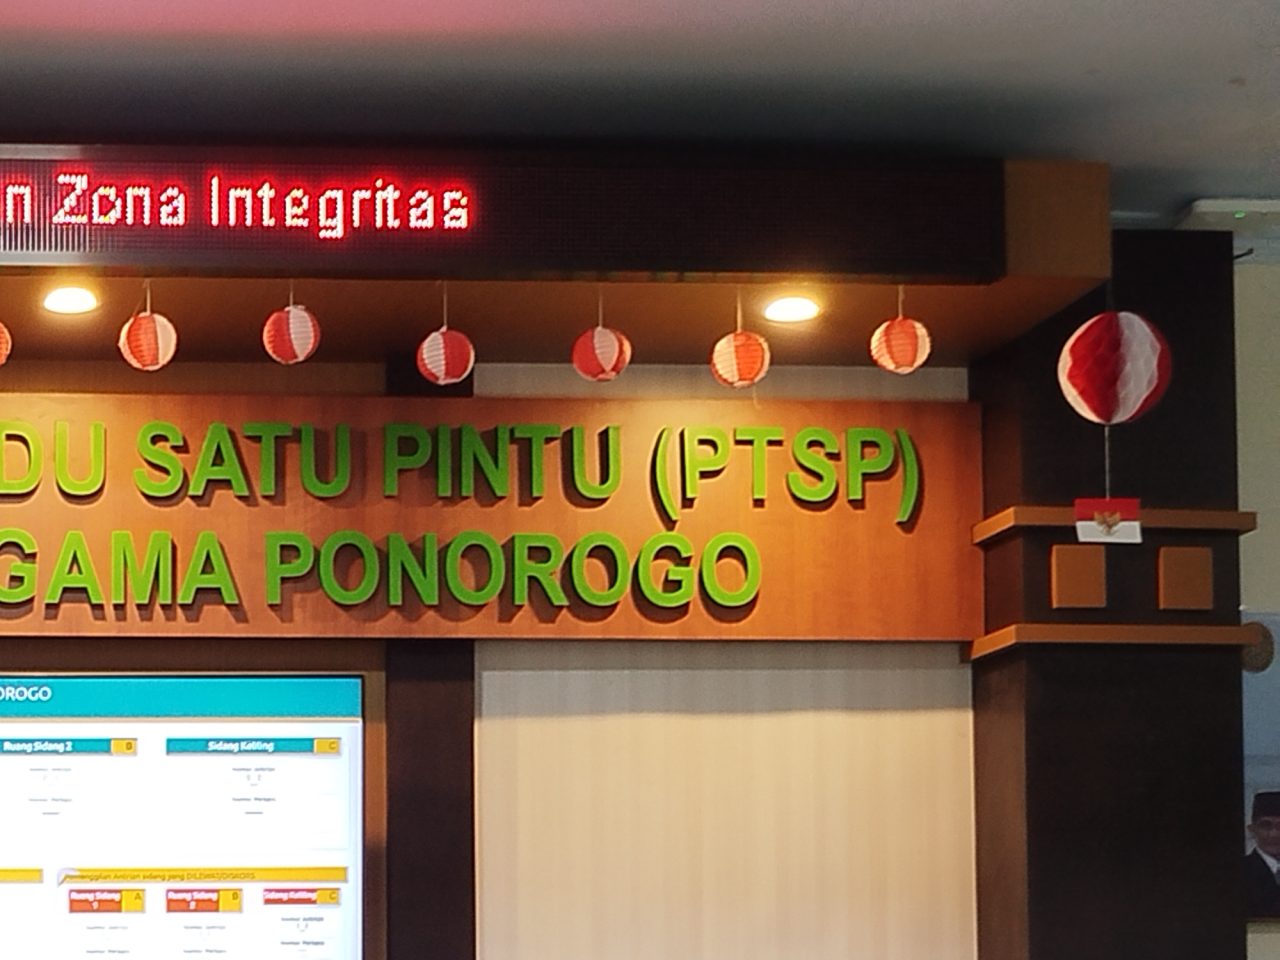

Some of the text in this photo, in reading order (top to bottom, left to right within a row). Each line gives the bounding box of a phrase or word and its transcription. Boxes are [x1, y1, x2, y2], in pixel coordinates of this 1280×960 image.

[210, 176, 469, 239] Integritas
[133, 422, 352, 500] SATU
[382, 425, 623, 500] PINTU
[655, 426, 921, 522] (PTSP)
[265, 531, 762, 608] PONOROGO
